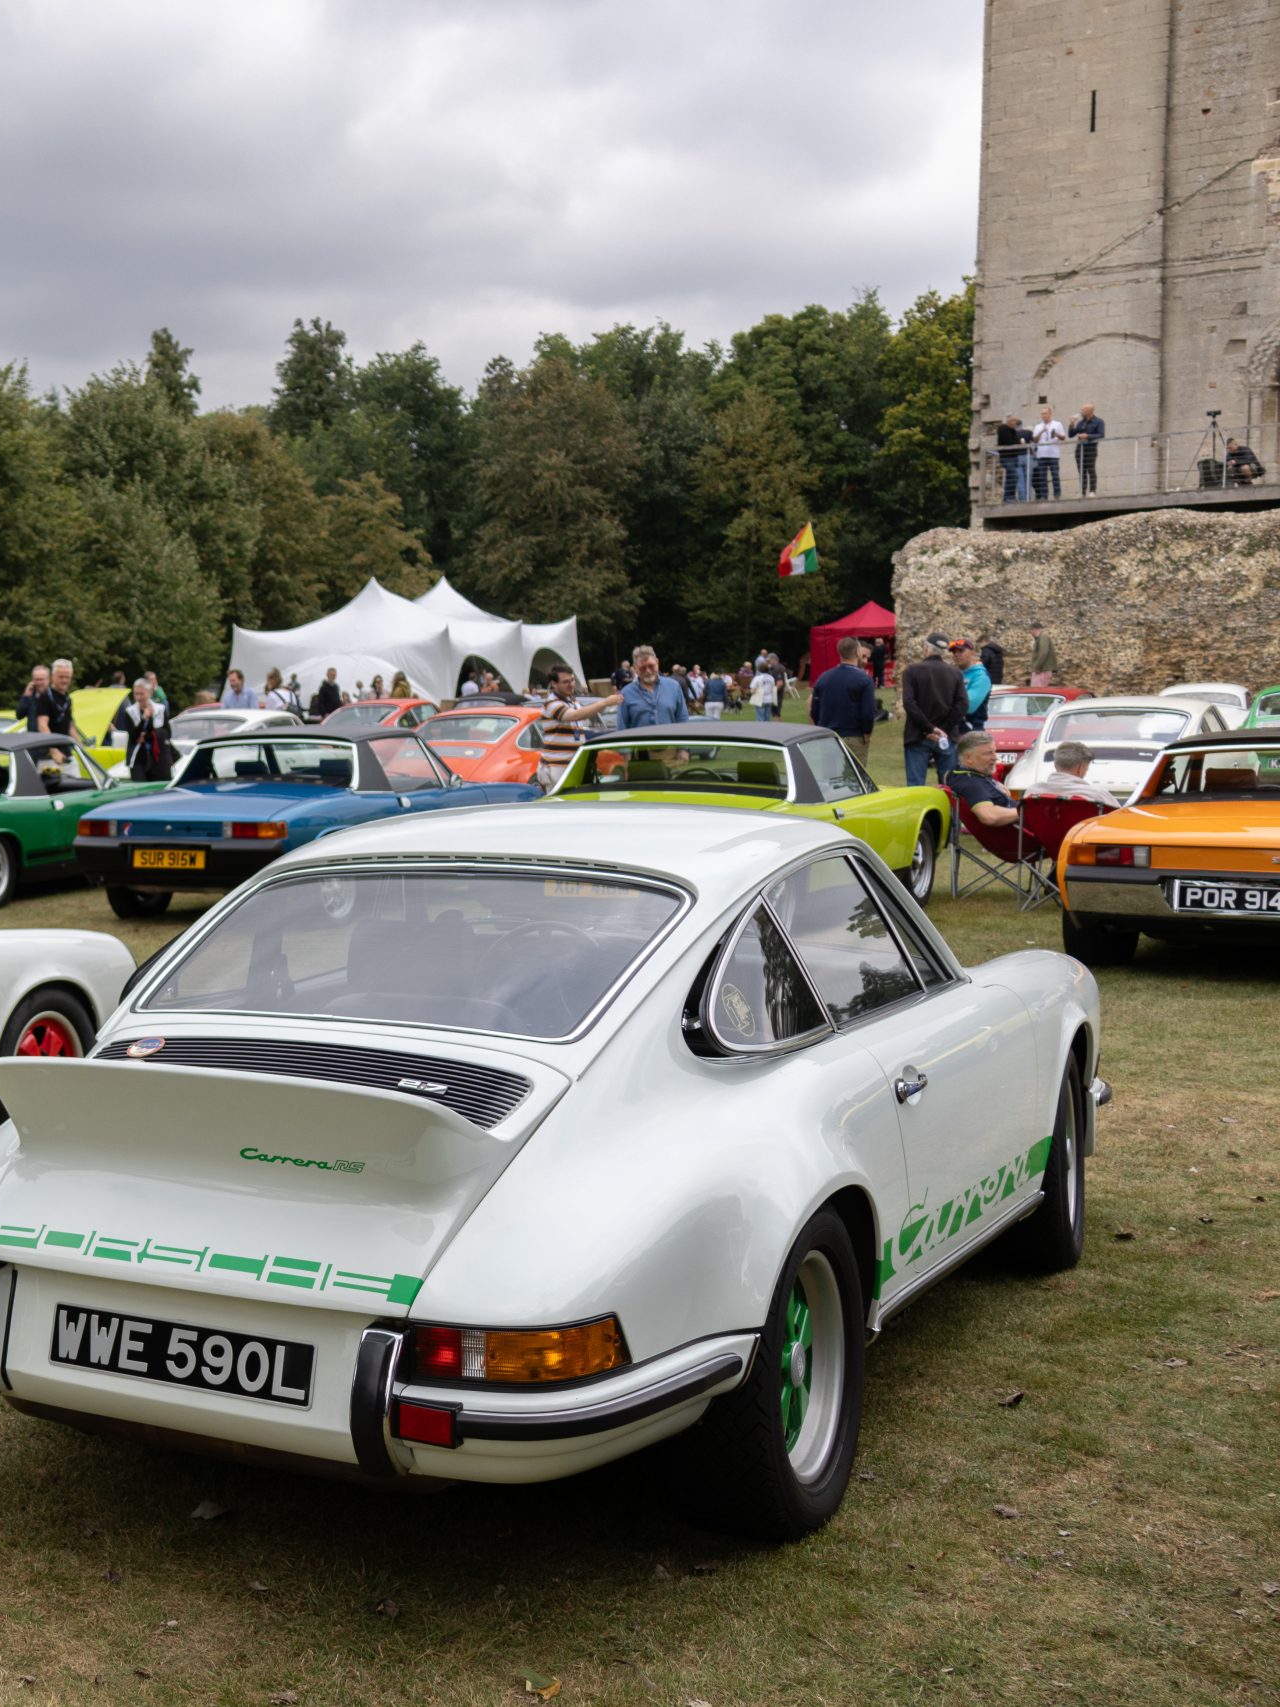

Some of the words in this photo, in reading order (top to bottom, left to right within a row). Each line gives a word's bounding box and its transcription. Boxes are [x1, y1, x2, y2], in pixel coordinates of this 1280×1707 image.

[140, 852, 164, 866] SUR
[168, 853, 197, 866] 915W
[1185, 887, 1237, 909] POR
[239, 1147, 332, 1170] Carrera
[891, 1150, 1034, 1269] Carrera
[57, 1309, 153, 1373] WWE
[165, 1328, 306, 1401] 590L
